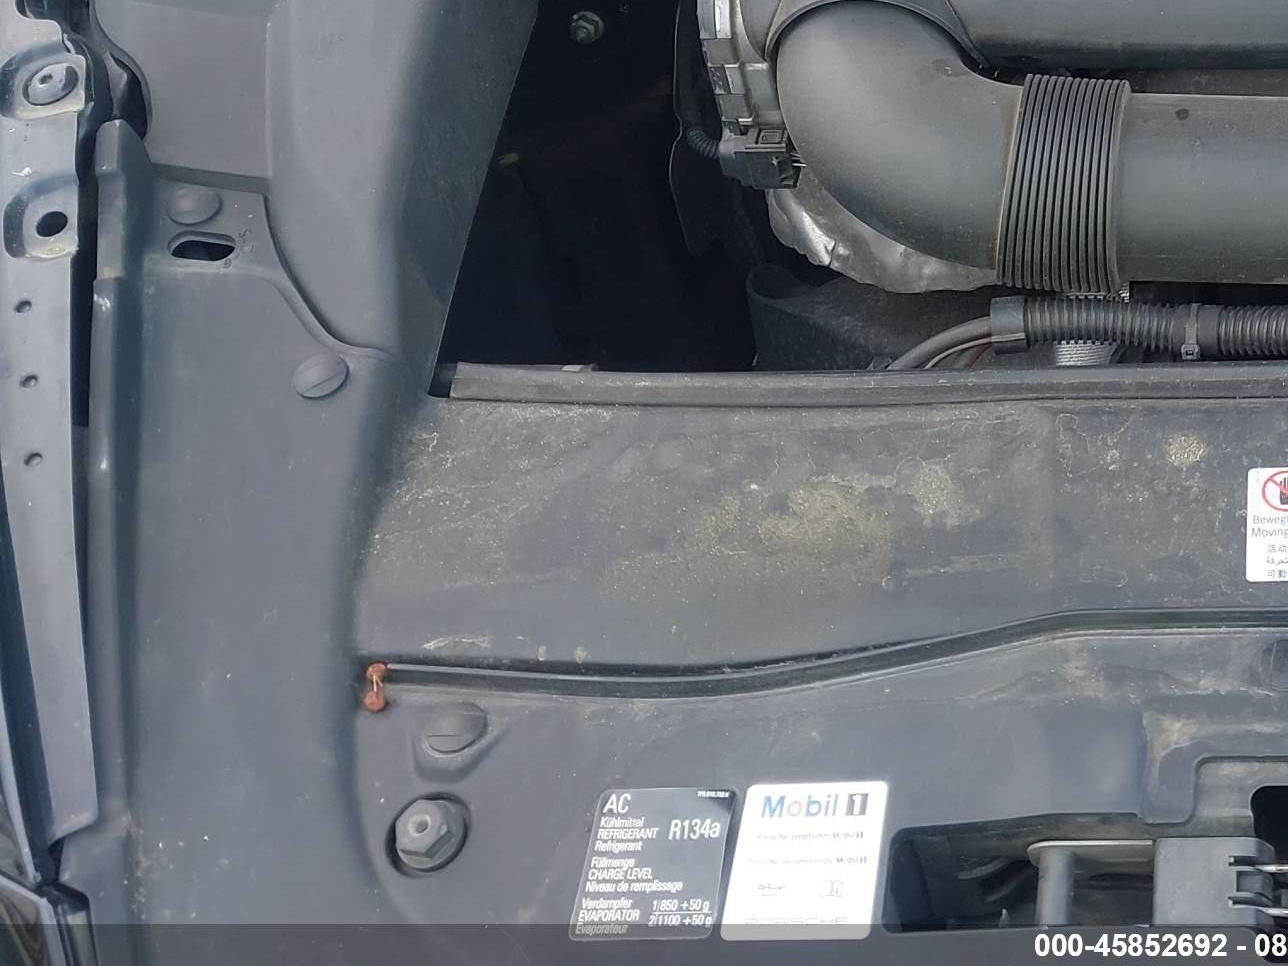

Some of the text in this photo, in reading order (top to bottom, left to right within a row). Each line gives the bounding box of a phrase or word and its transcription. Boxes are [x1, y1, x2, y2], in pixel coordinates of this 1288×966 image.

[603, 793, 631, 814] AC
[761, 793, 839, 818] Mobil
[600, 816, 645, 828] Kühlmittel
[668, 818, 721, 840] R134a
[597, 827, 659, 840] REFRIGERANT
[594, 840, 643, 854] Refrigerant
[591, 856, 635, 870] Füllmenge
[588, 867, 653, 880] CHARGE LEVEL
[585, 880, 684, 894] Niveau de remplissage
[582, 897, 632, 910] Verdampfer
[578, 909, 640, 923] EVAPORATOR
